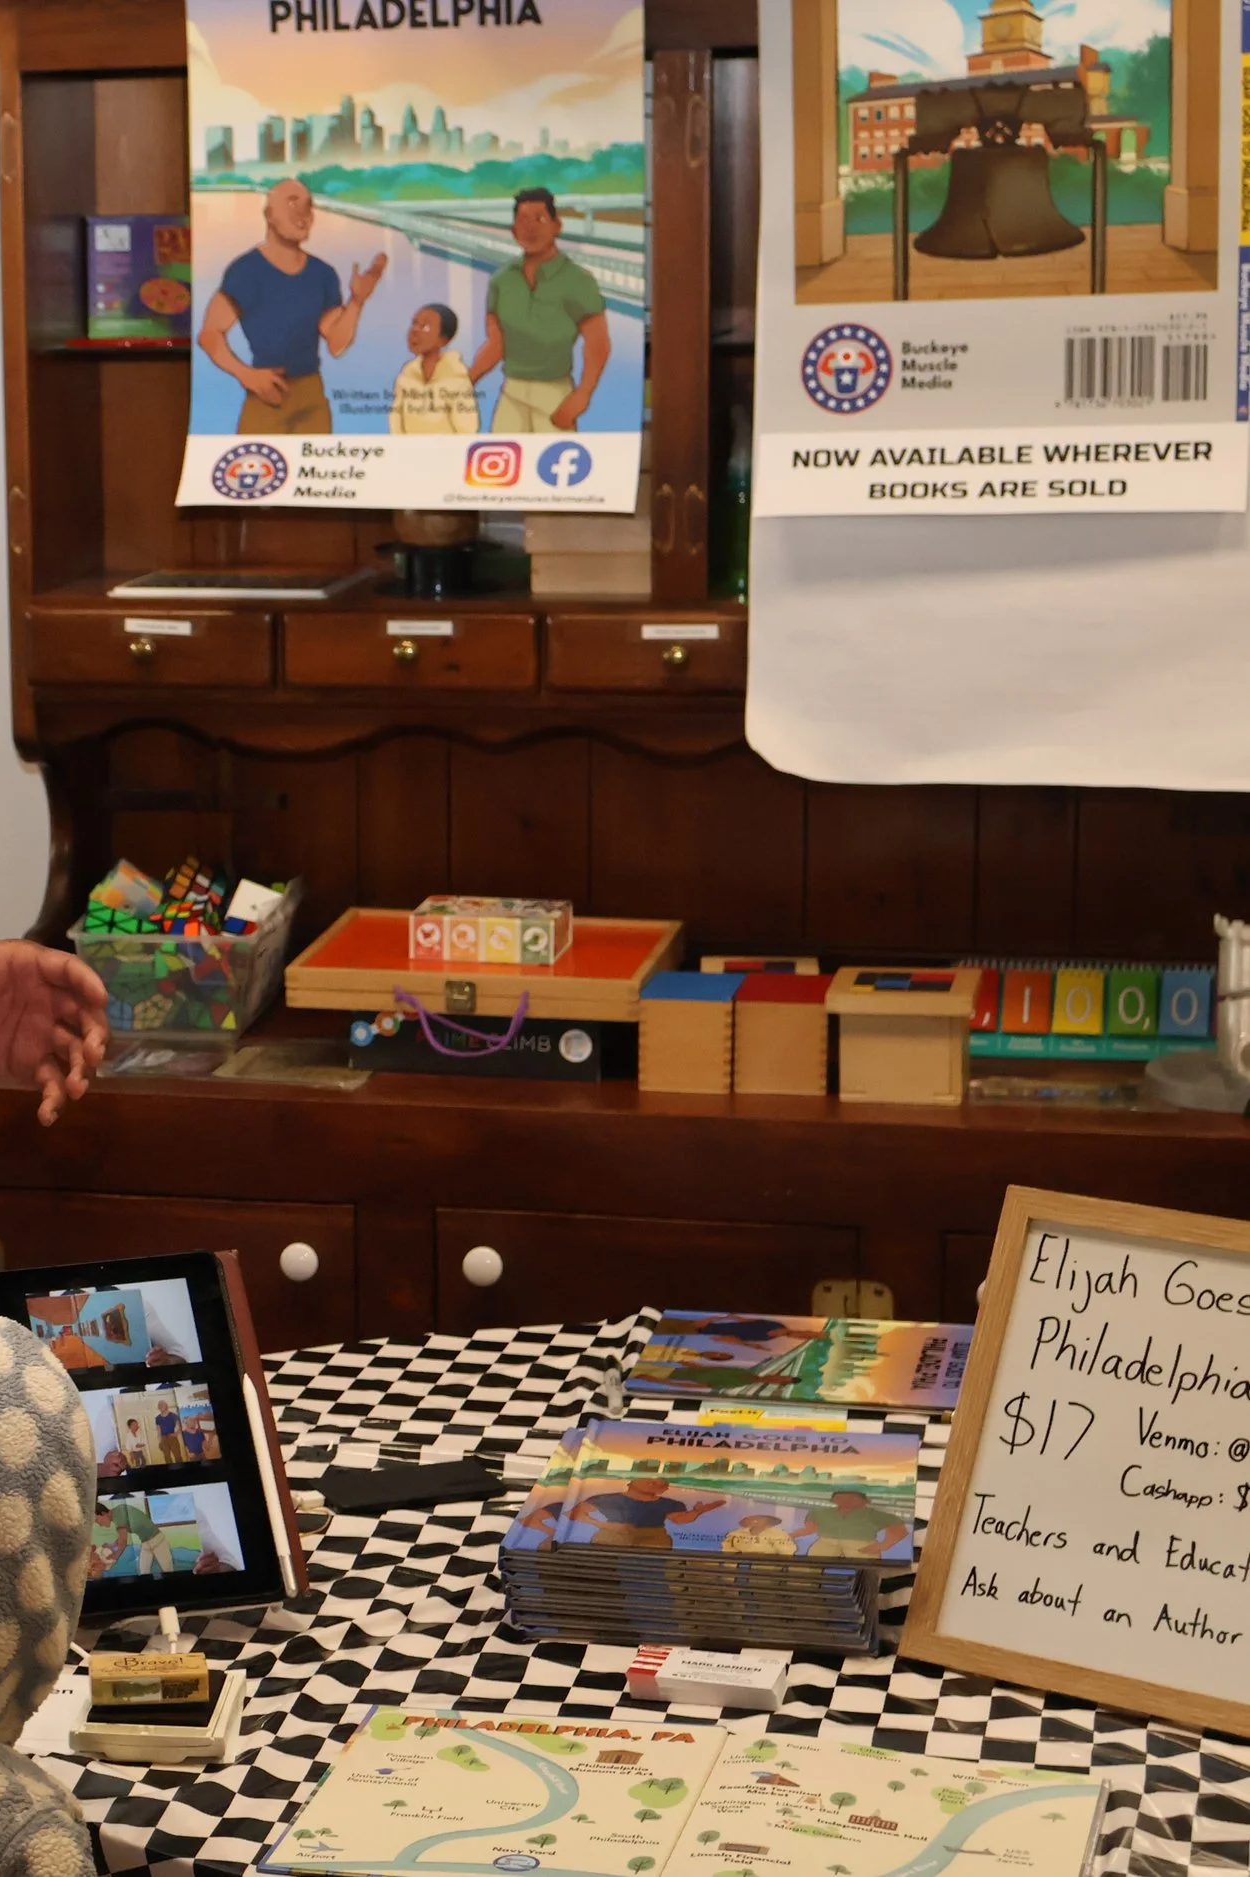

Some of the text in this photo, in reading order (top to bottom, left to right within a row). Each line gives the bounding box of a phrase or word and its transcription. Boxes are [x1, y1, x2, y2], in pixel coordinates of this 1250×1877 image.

[269, 0, 542, 33] PHILADELPHIA
[901, 339, 969, 358] Buckeye
[901, 357, 958, 373] Muscle
[901, 374, 953, 390] Media
[301, 441, 385, 461] Buckeye
[792, 441, 1213, 469] NOW AVAILABLE WHEREVER
[297, 466, 366, 481] Muscle
[293, 485, 357, 499] Media
[868, 479, 1129, 500] BOOKS ARE SOLD
[1029, 1233, 1250, 1316] Elijah Goes
[1030, 1316, 1250, 1405] Philadelphia
[999, 1391, 1095, 1461] $17
[1138, 1406, 1221, 1459] Venmo:
[646, 1436, 861, 1454] PHILADELPHIA
[662, 1428, 849, 1444] ELIJAH GOES TO
[1120, 1464, 1224, 1509] Cashapp:
[973, 1492, 1068, 1549] Teachers
[1092, 1530, 1140, 1564] and
[961, 1565, 1244, 1645] Ask about an Author
[402, 1715, 696, 1744] PHILADELPHIA, PA
[568, 1767, 617, 1775] Museum
[577, 1763, 649, 1772] Philadelphia
[486, 1800, 542, 1809] University
[390, 1811, 434, 1820] Franklin
[589, 1836, 660, 1845] Philadelphia
[296, 1852, 337, 1860] Airport
[492, 1846, 557, 1856] Navy Yard
[724, 1858, 753, 1866] Field
